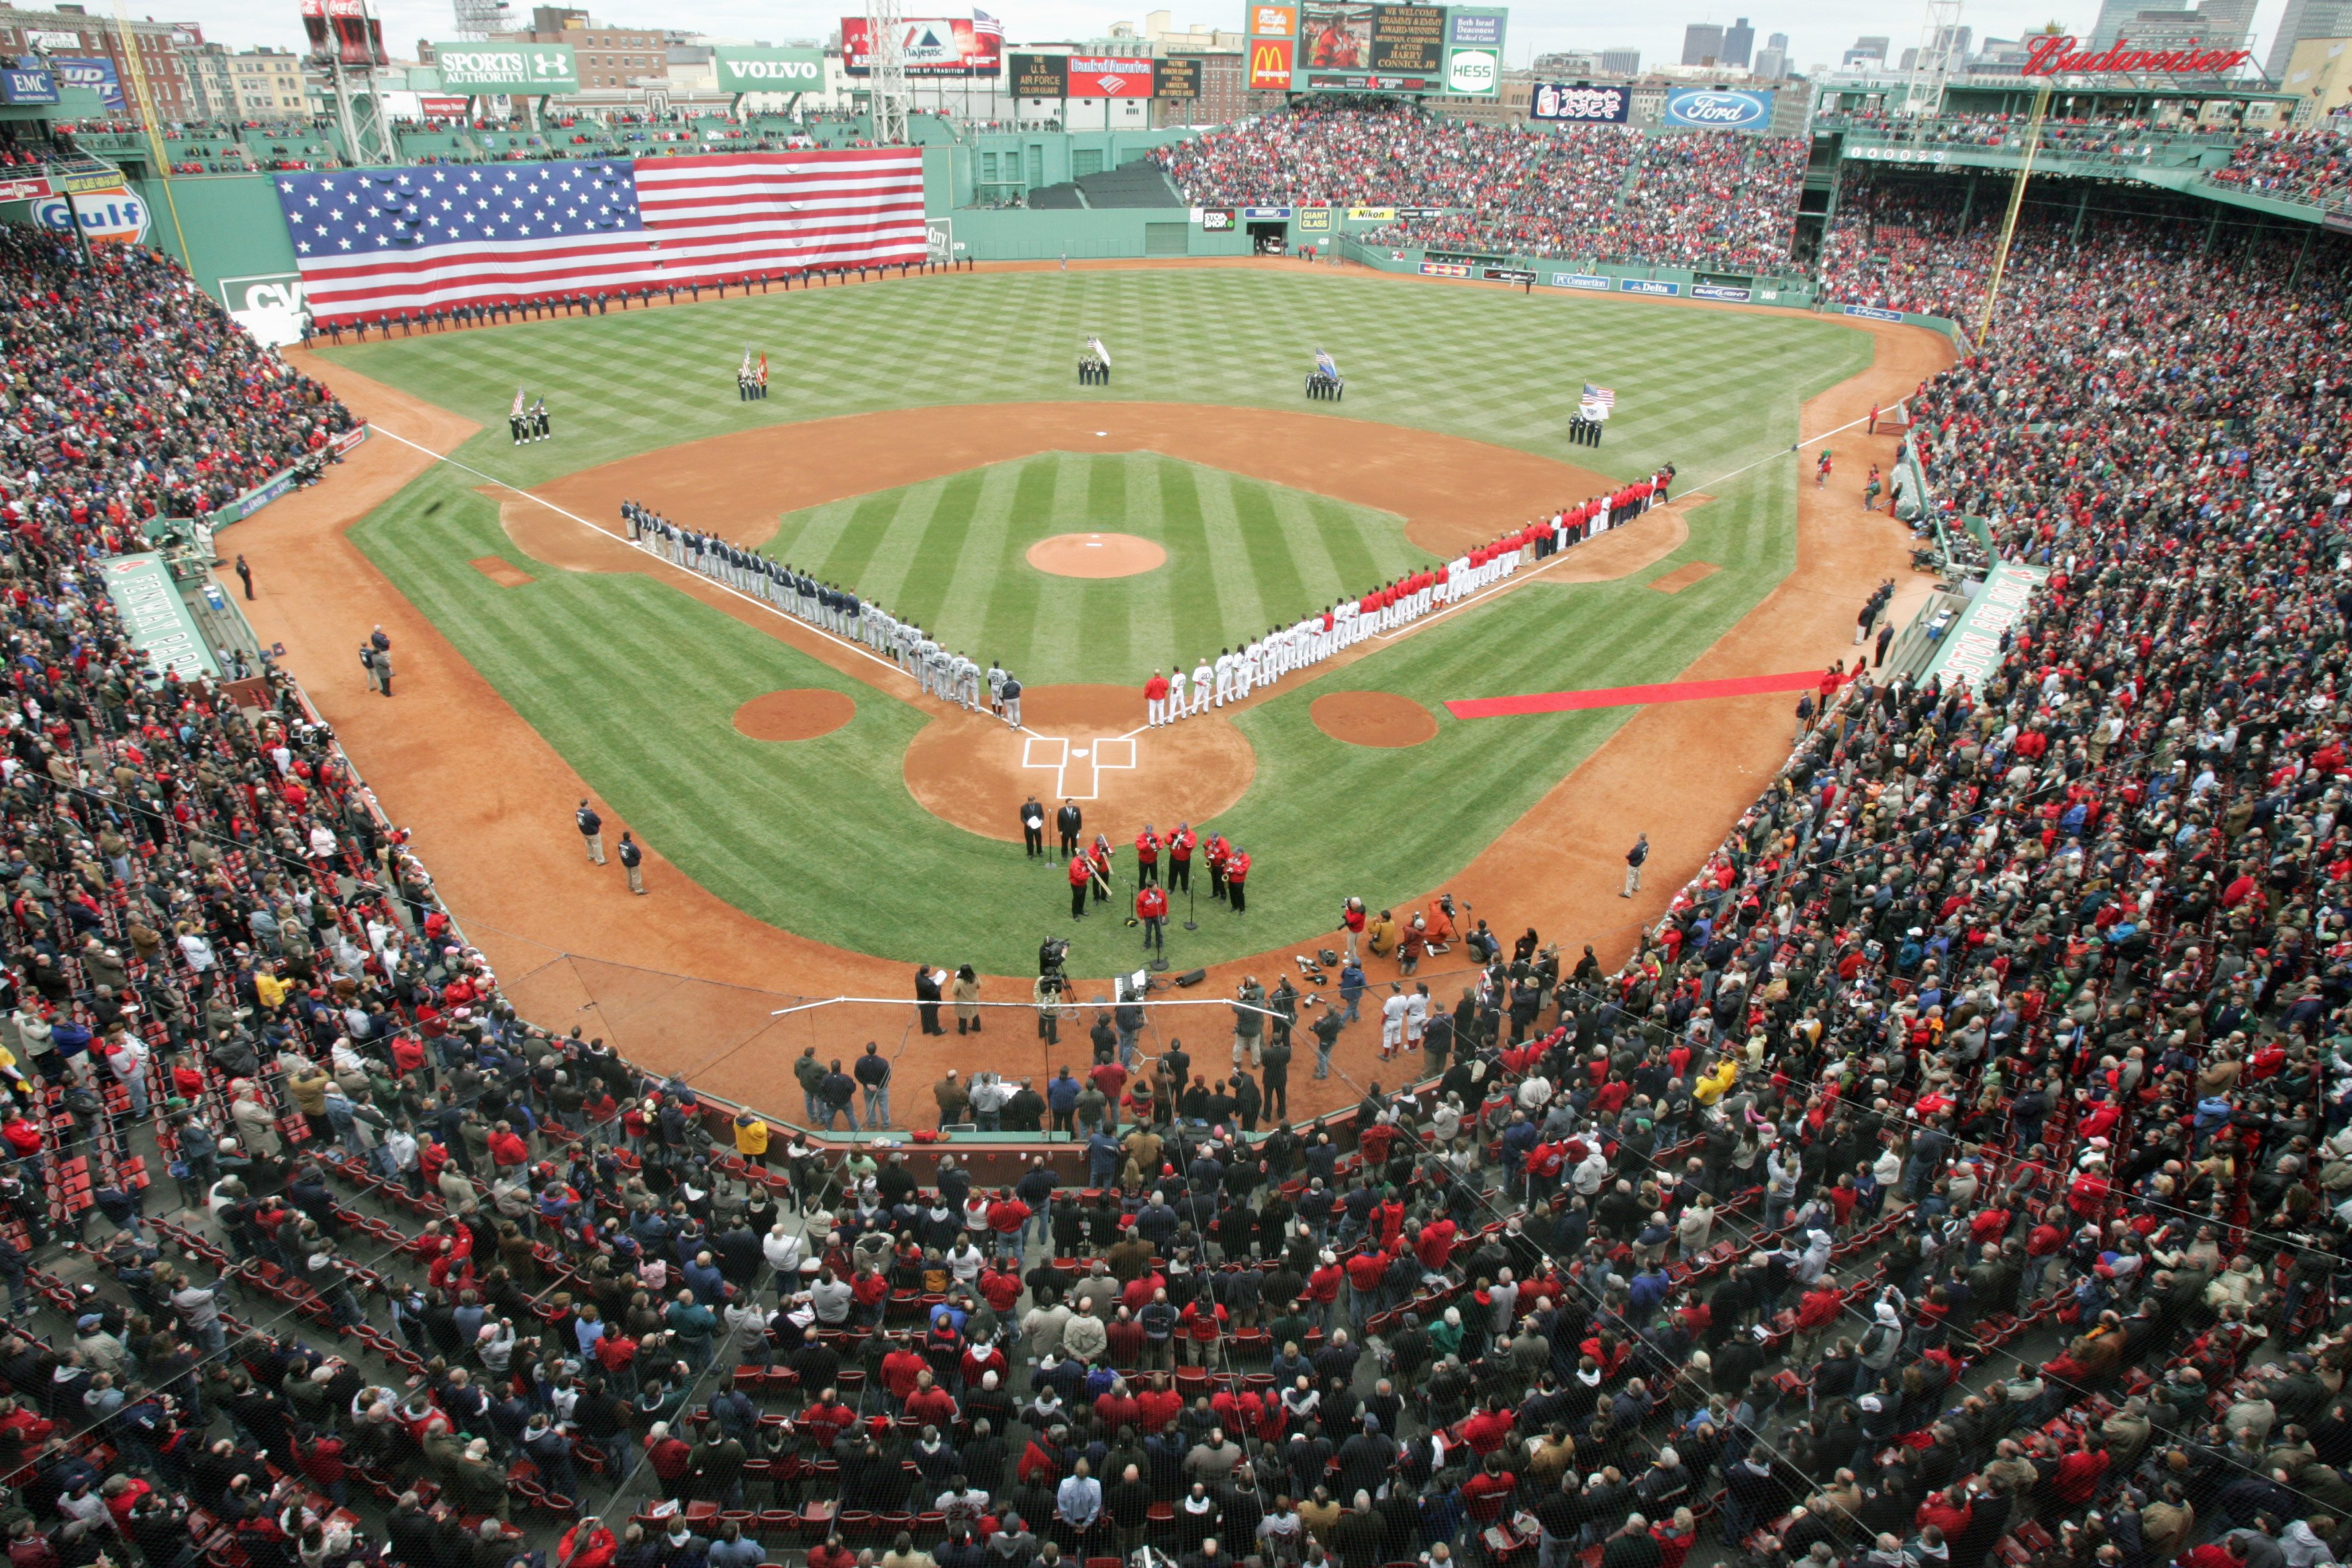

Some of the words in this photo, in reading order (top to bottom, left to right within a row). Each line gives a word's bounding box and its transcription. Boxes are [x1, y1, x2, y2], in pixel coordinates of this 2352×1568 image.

[1385, 7, 1398, 15] WE
[1399, 7, 1437, 17] WELCOME
[1379, 16, 1412, 25] GRAMMY
[1457, 18, 1473, 26] Beth
[1476, 19, 1495, 27] Israel
[1380, 26, 1439, 35] AWARD-WINNING
[1457, 26, 1494, 34] Deaconess
[1391, 51, 1423, 59] HARRY
[2021, 35, 2251, 76] Budweiser
[441, 53, 523, 72] SPORTS
[1071, 59, 1097, 72] Bank
[1097, 59, 1108, 72] of
[1110, 60, 1150, 73] America
[1378, 59, 1422, 69] CONNICK,
[1425, 61, 1436, 69] JR
[65, 69, 104, 81] UD
[726, 61, 817, 79] VOLVO
[1257, 70, 1289, 78] McDonald's
[1453, 65, 1491, 78] HESS
[446, 72, 524, 83] AUTHORITY
[1020, 76, 1033, 85] AIR
[1034, 76, 1060, 85] FORCE
[1404, 79, 1425, 88] 2007
[424, 102, 450, 111] Sovereign
[1559, 100, 1620, 119] ようこそ
[1686, 94, 1746, 120] Ford
[42, 203, 140, 229] Gulf
[1304, 211, 1328, 219] GIANT
[1358, 210, 1384, 218] Nikon
[1556, 275, 1567, 284] PC
[1567, 277, 1606, 287] Connection
[1643, 283, 1668, 293] Delta
[1718, 289, 1747, 298] LIGHT
[246, 282, 311, 313] CV
[1761, 291, 1776, 300] 380
[248, 493, 267, 511] Delta
[1987, 577, 2031, 607] SOX
[120, 573, 182, 634] FENWAY
[1969, 603, 2016, 633] RED
[142, 632, 203, 679] PARK
